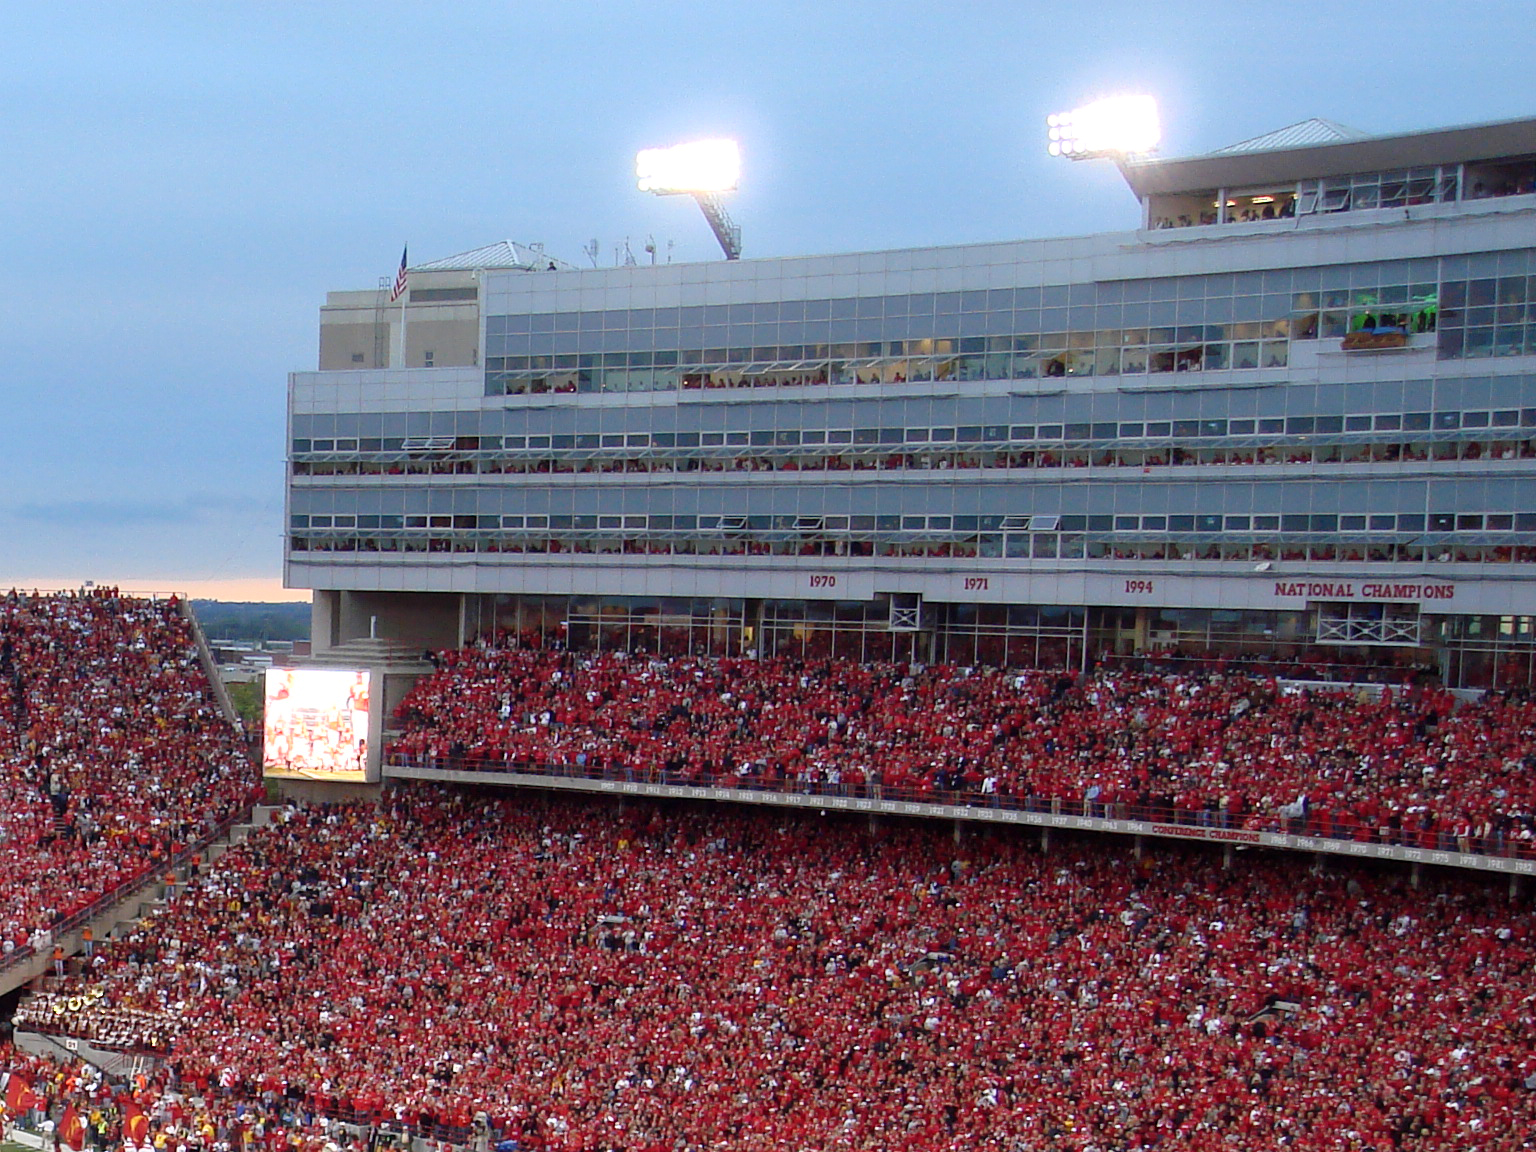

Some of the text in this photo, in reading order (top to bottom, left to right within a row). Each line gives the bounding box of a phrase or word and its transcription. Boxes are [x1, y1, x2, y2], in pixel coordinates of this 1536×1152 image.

[810, 575, 1153, 594] 1970 1971 1994
[1275, 582, 1454, 599] NATIONAL CHAMPIONS
[646, 786, 660, 794] 1911
[1209, 829, 1260, 843] CHAMPIONS
[1377, 846, 1394, 857] 1971
[1515, 861, 1533, 872] 1982
